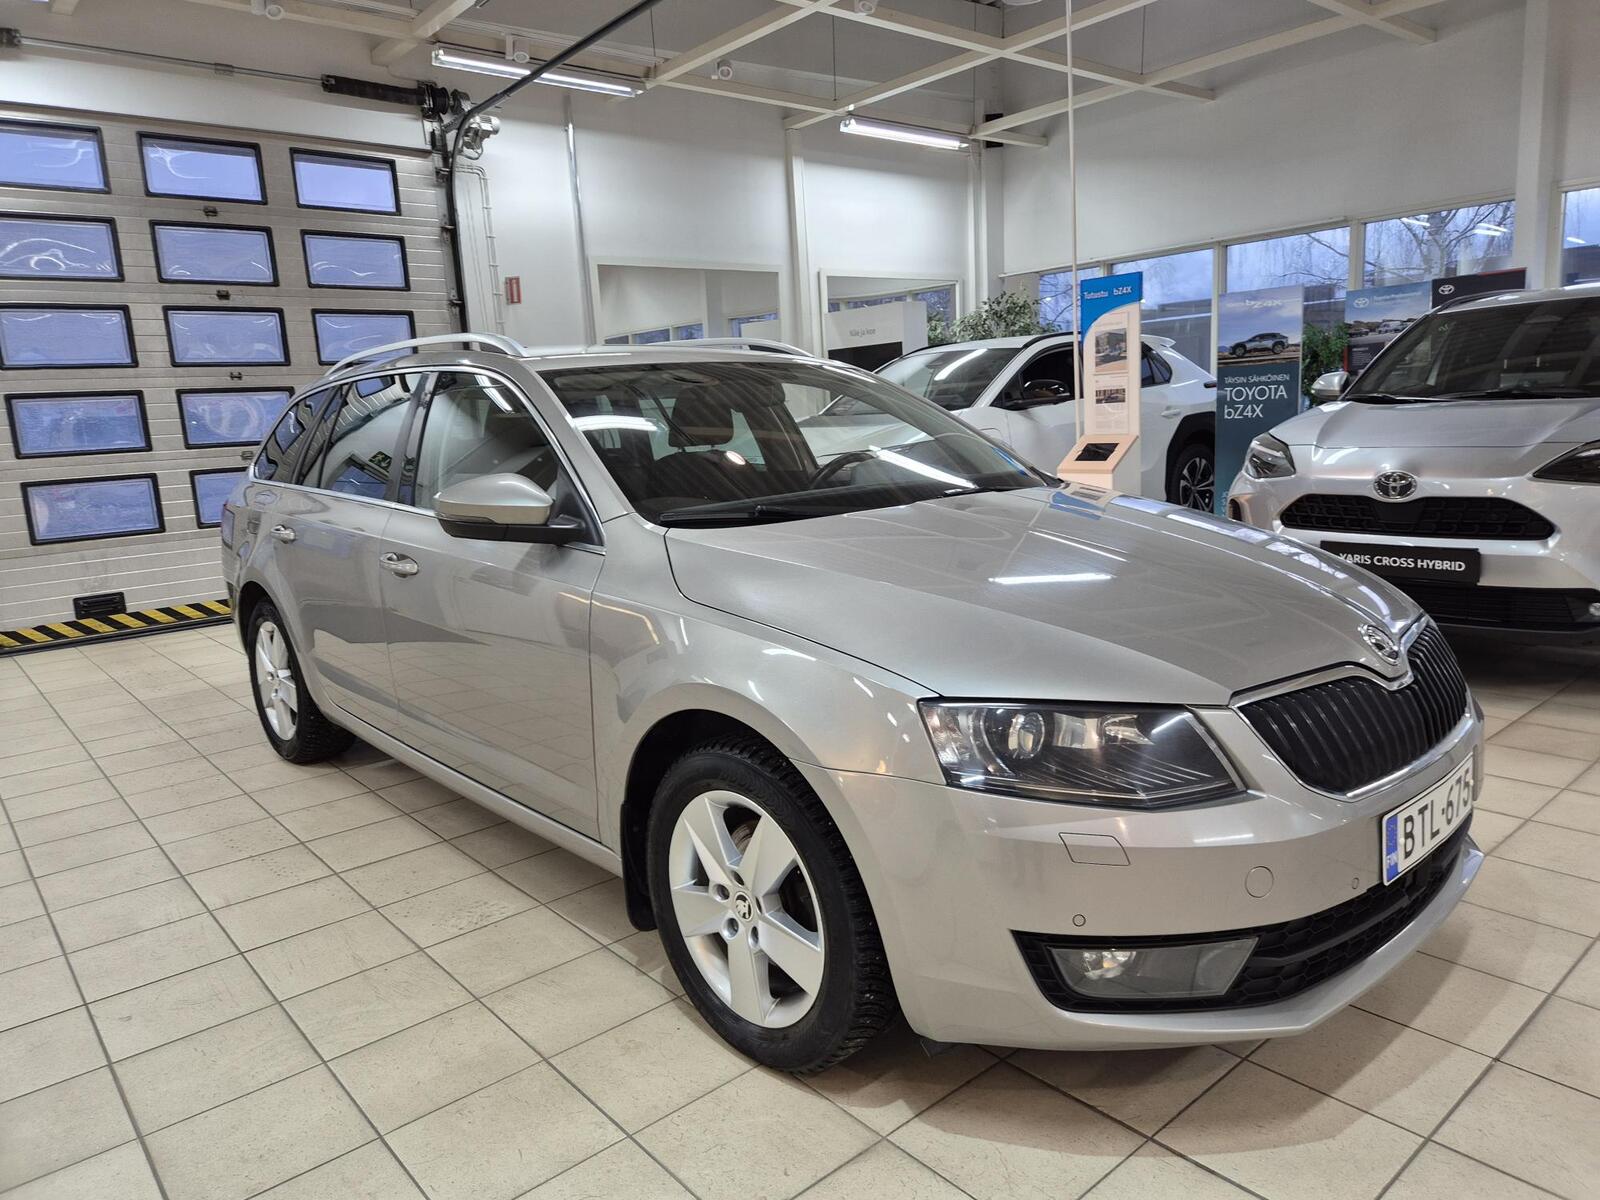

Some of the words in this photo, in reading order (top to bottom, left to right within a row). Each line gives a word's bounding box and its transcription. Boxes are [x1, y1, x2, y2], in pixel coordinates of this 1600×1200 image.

[1113, 286, 1133, 296] bZ4X
[1224, 375, 1247, 384] TÄYSIN
[1248, 373, 1290, 383] SÄHKÖINEN
[1224, 385, 1288, 401] TOYOTA
[1224, 404, 1264, 419] bZ4X
[1340, 553, 1371, 565] YARIS
[1373, 556, 1415, 568] CROSS
[1417, 559, 1466, 572] HYBRID
[1403, 766, 1470, 860] BTL-675
